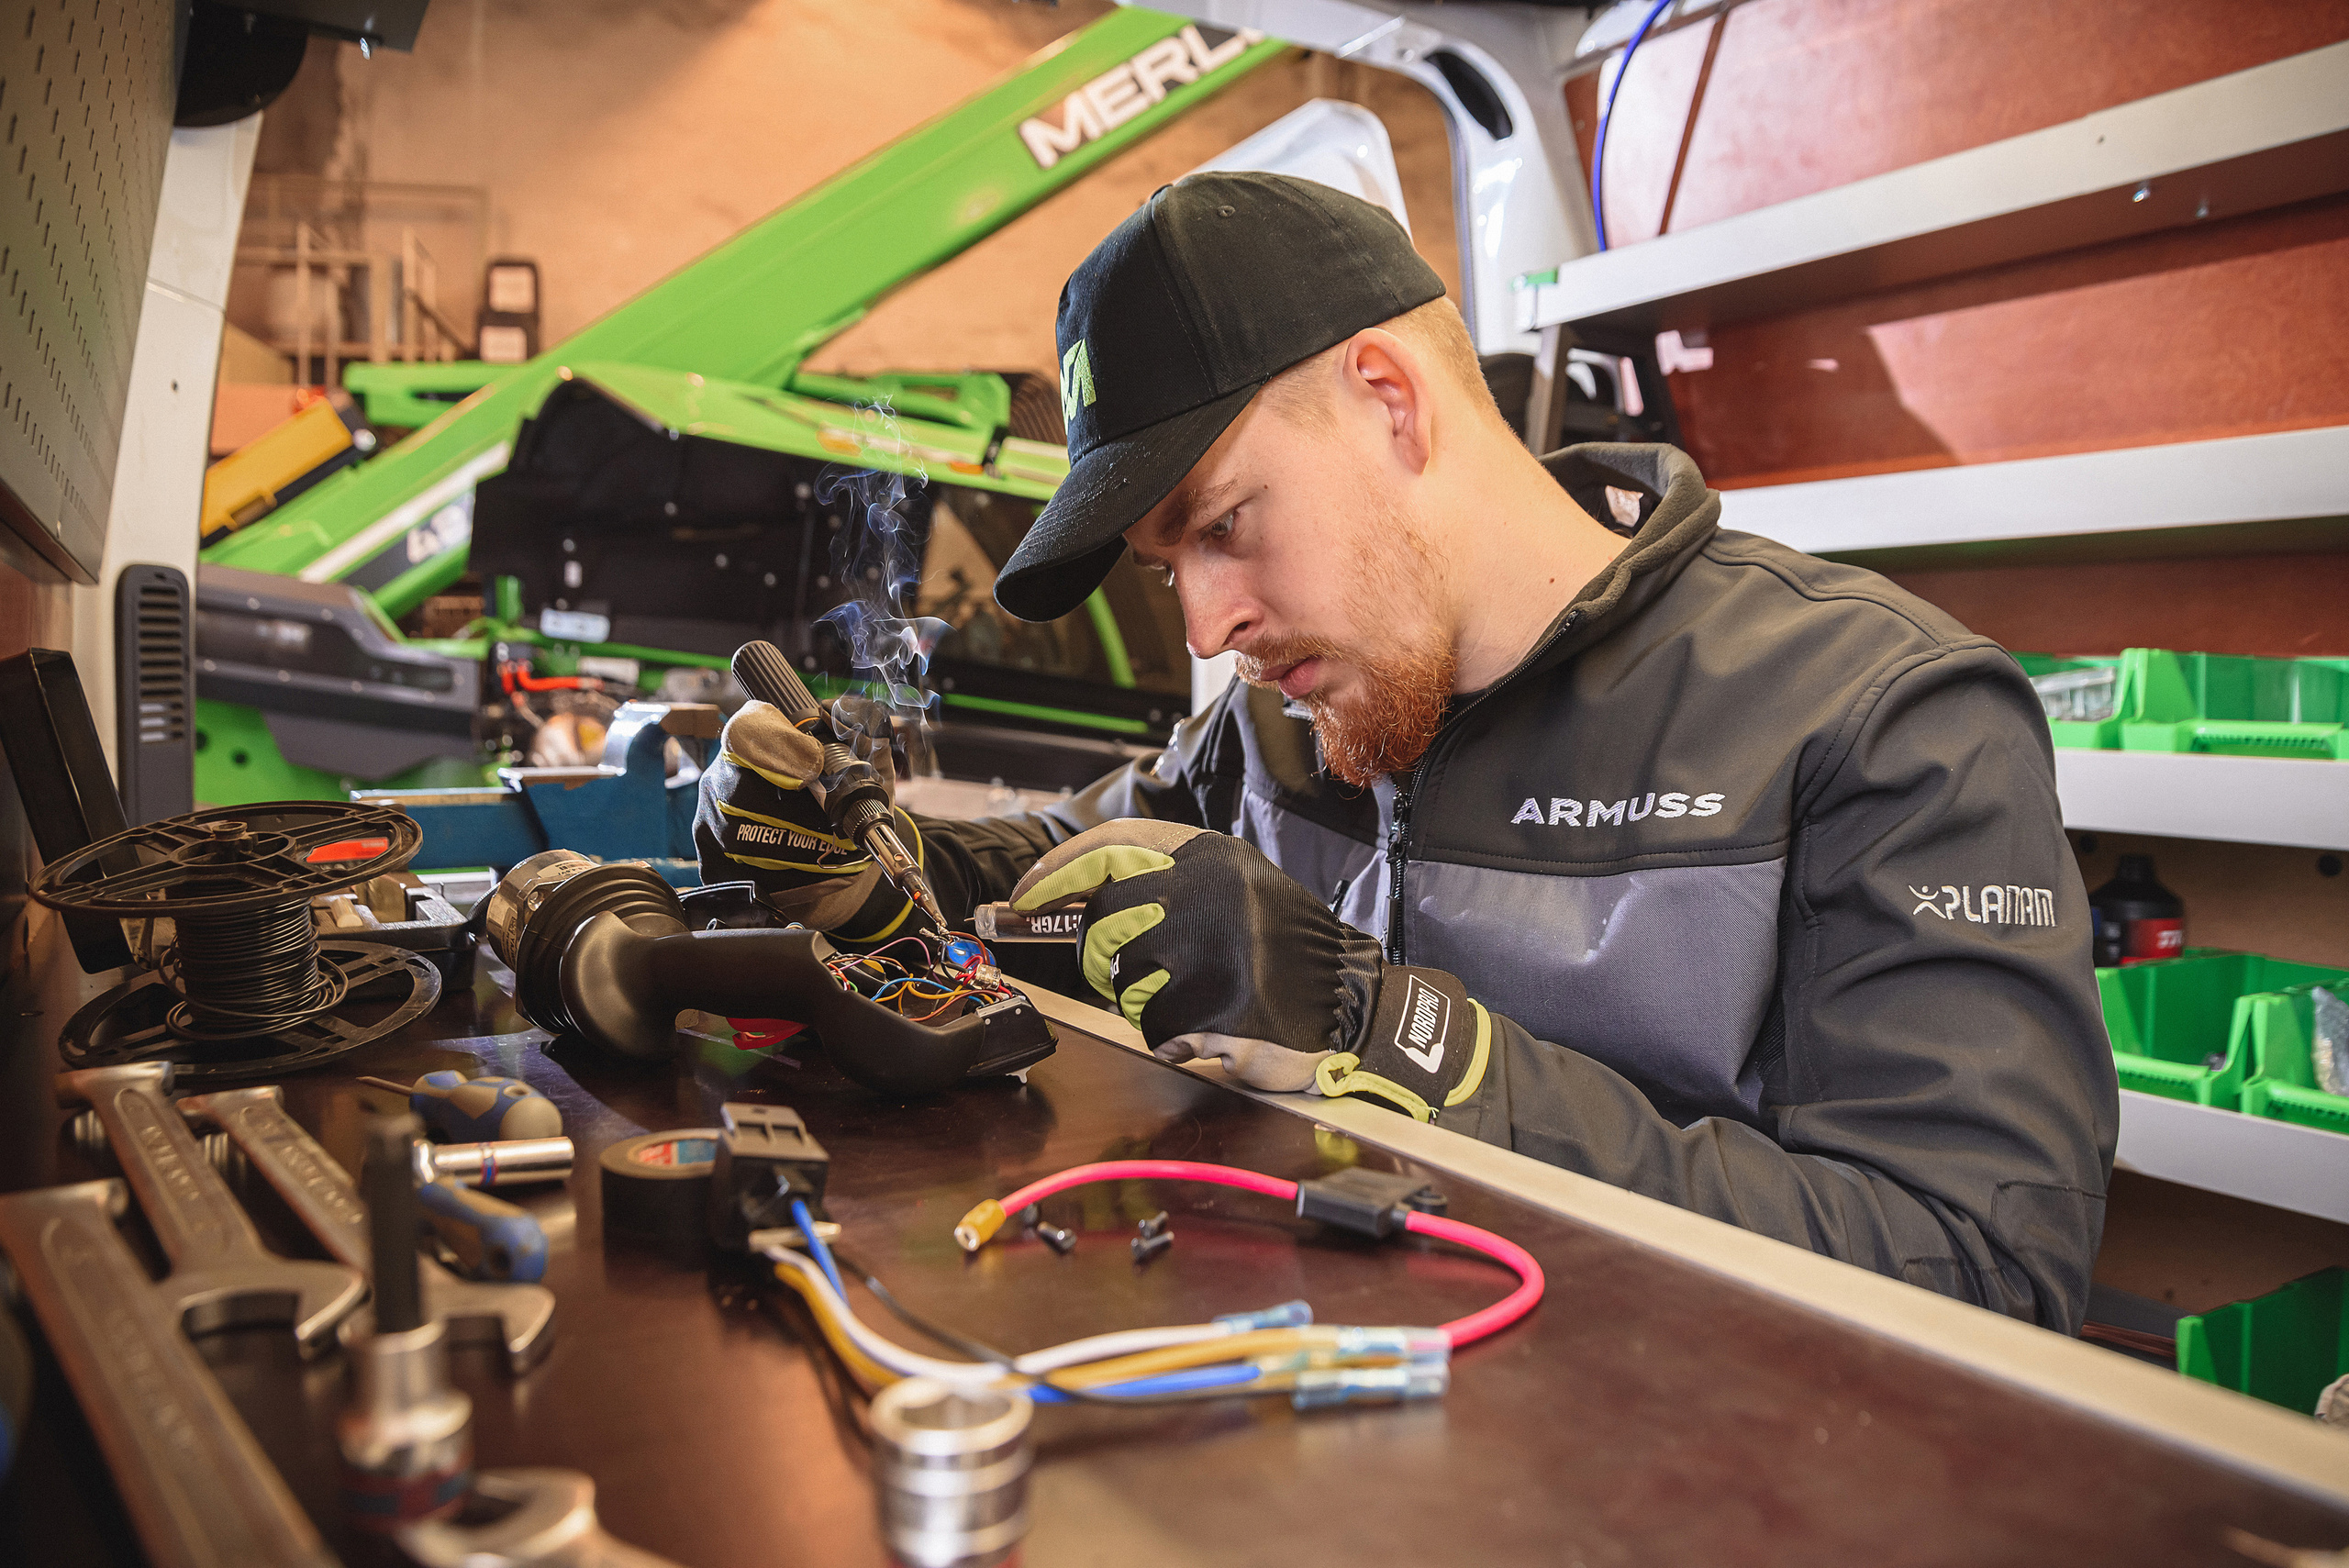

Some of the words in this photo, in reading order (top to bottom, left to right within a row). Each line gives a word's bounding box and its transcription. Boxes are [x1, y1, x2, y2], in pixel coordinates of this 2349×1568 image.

[1019, 24, 1265, 169] MERL
[1510, 792, 1726, 828] ARMUSS
[737, 824, 787, 845] PROTECT
[787, 830, 818, 850] YOUR
[1408, 987, 1440, 1050] NORDPRO
